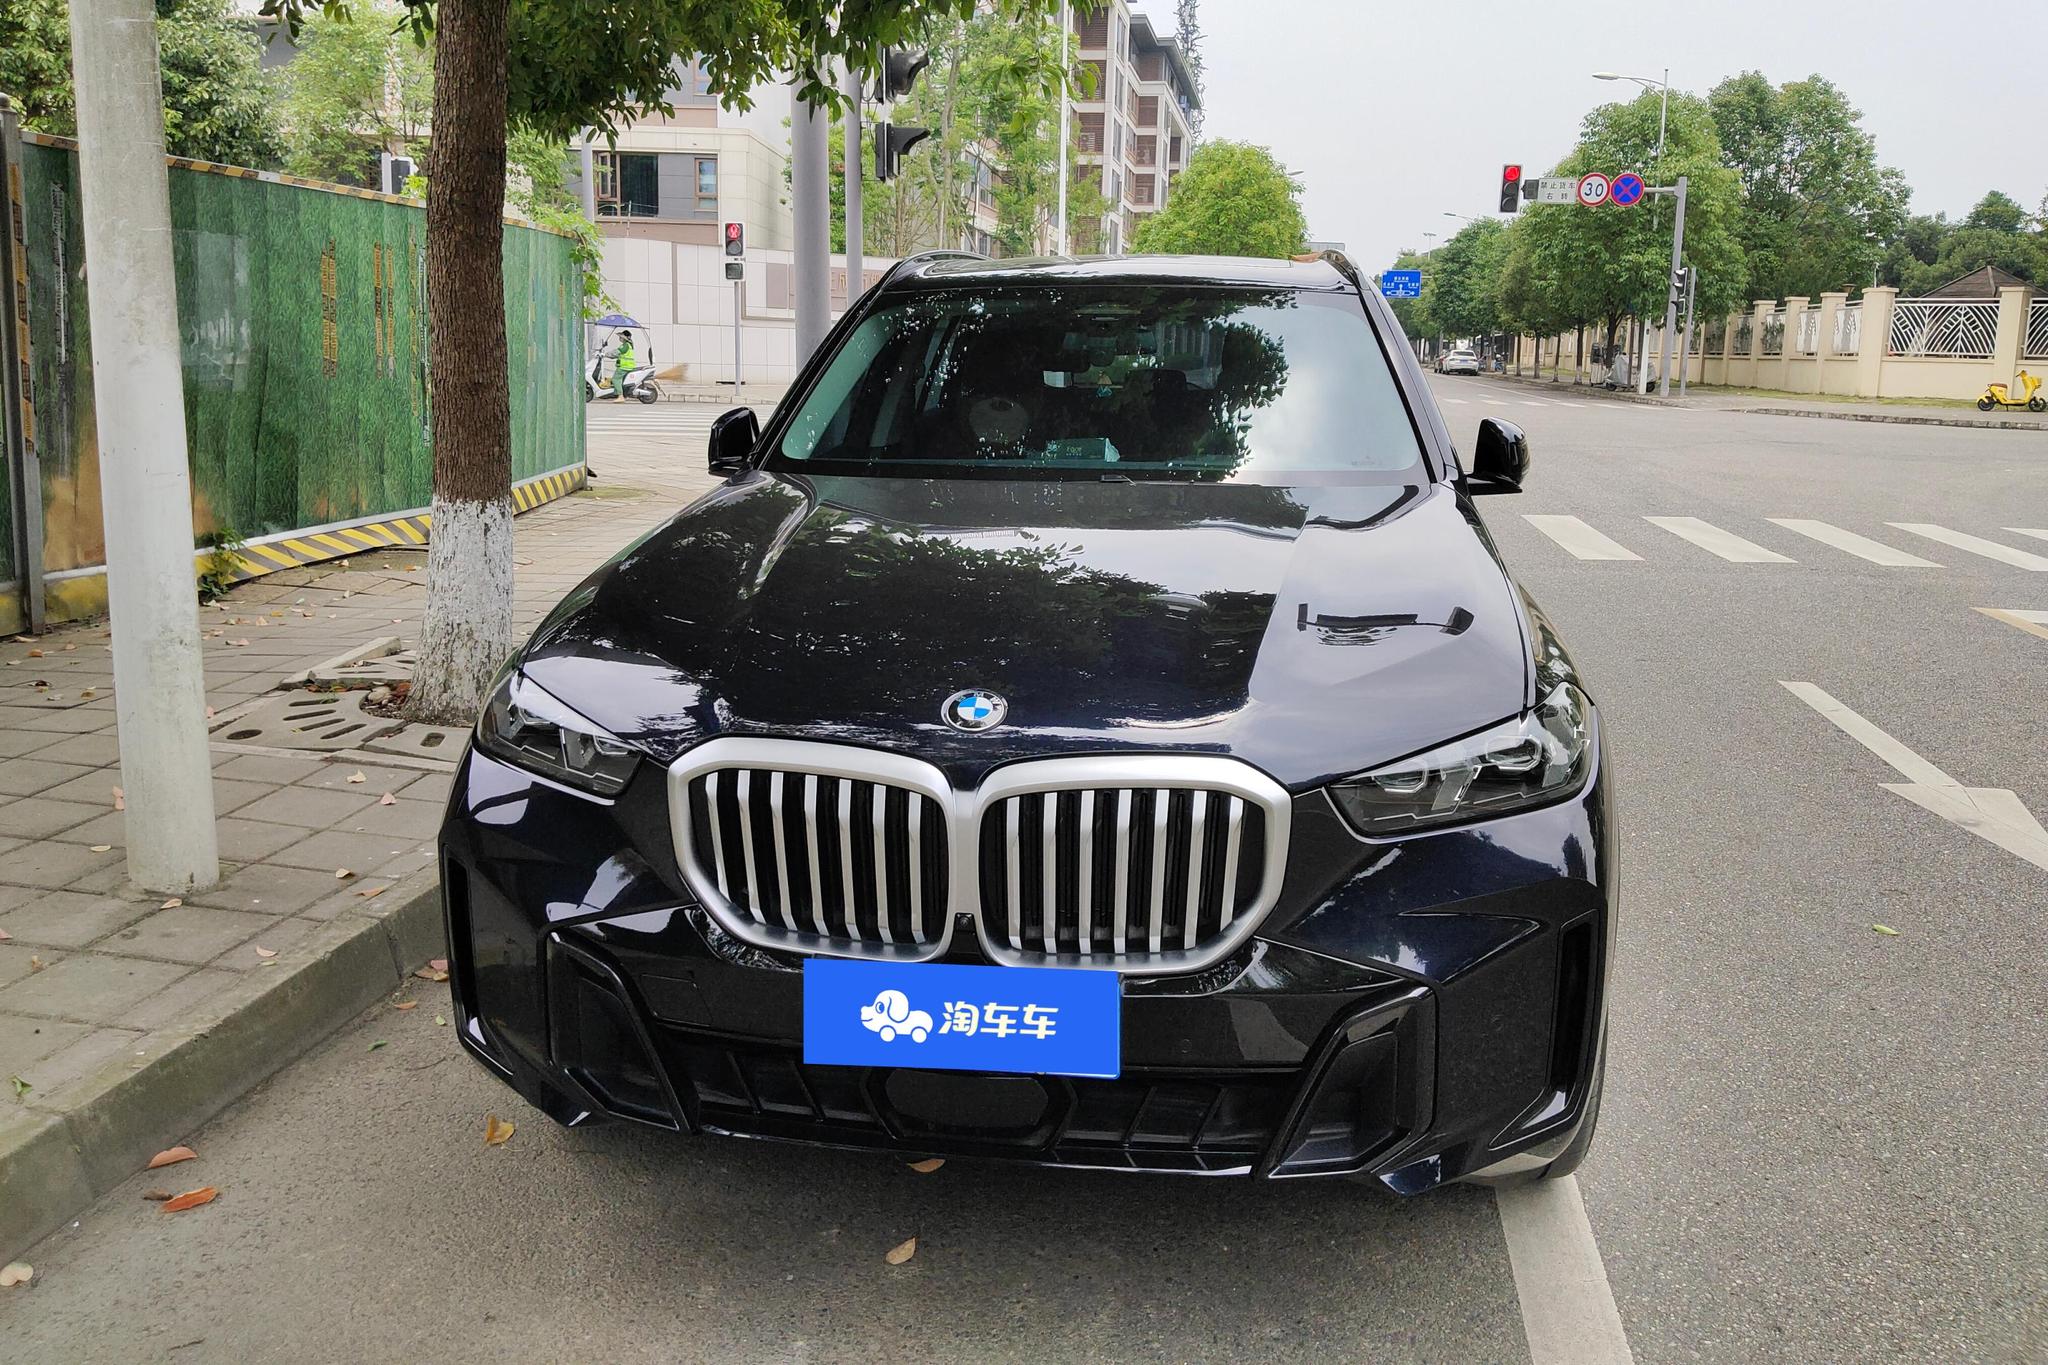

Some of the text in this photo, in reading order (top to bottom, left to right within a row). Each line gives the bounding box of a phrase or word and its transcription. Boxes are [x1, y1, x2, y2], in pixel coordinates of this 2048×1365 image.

[1540, 181, 1576, 190] 禁止货车
[1584, 182, 1604, 197] 30
